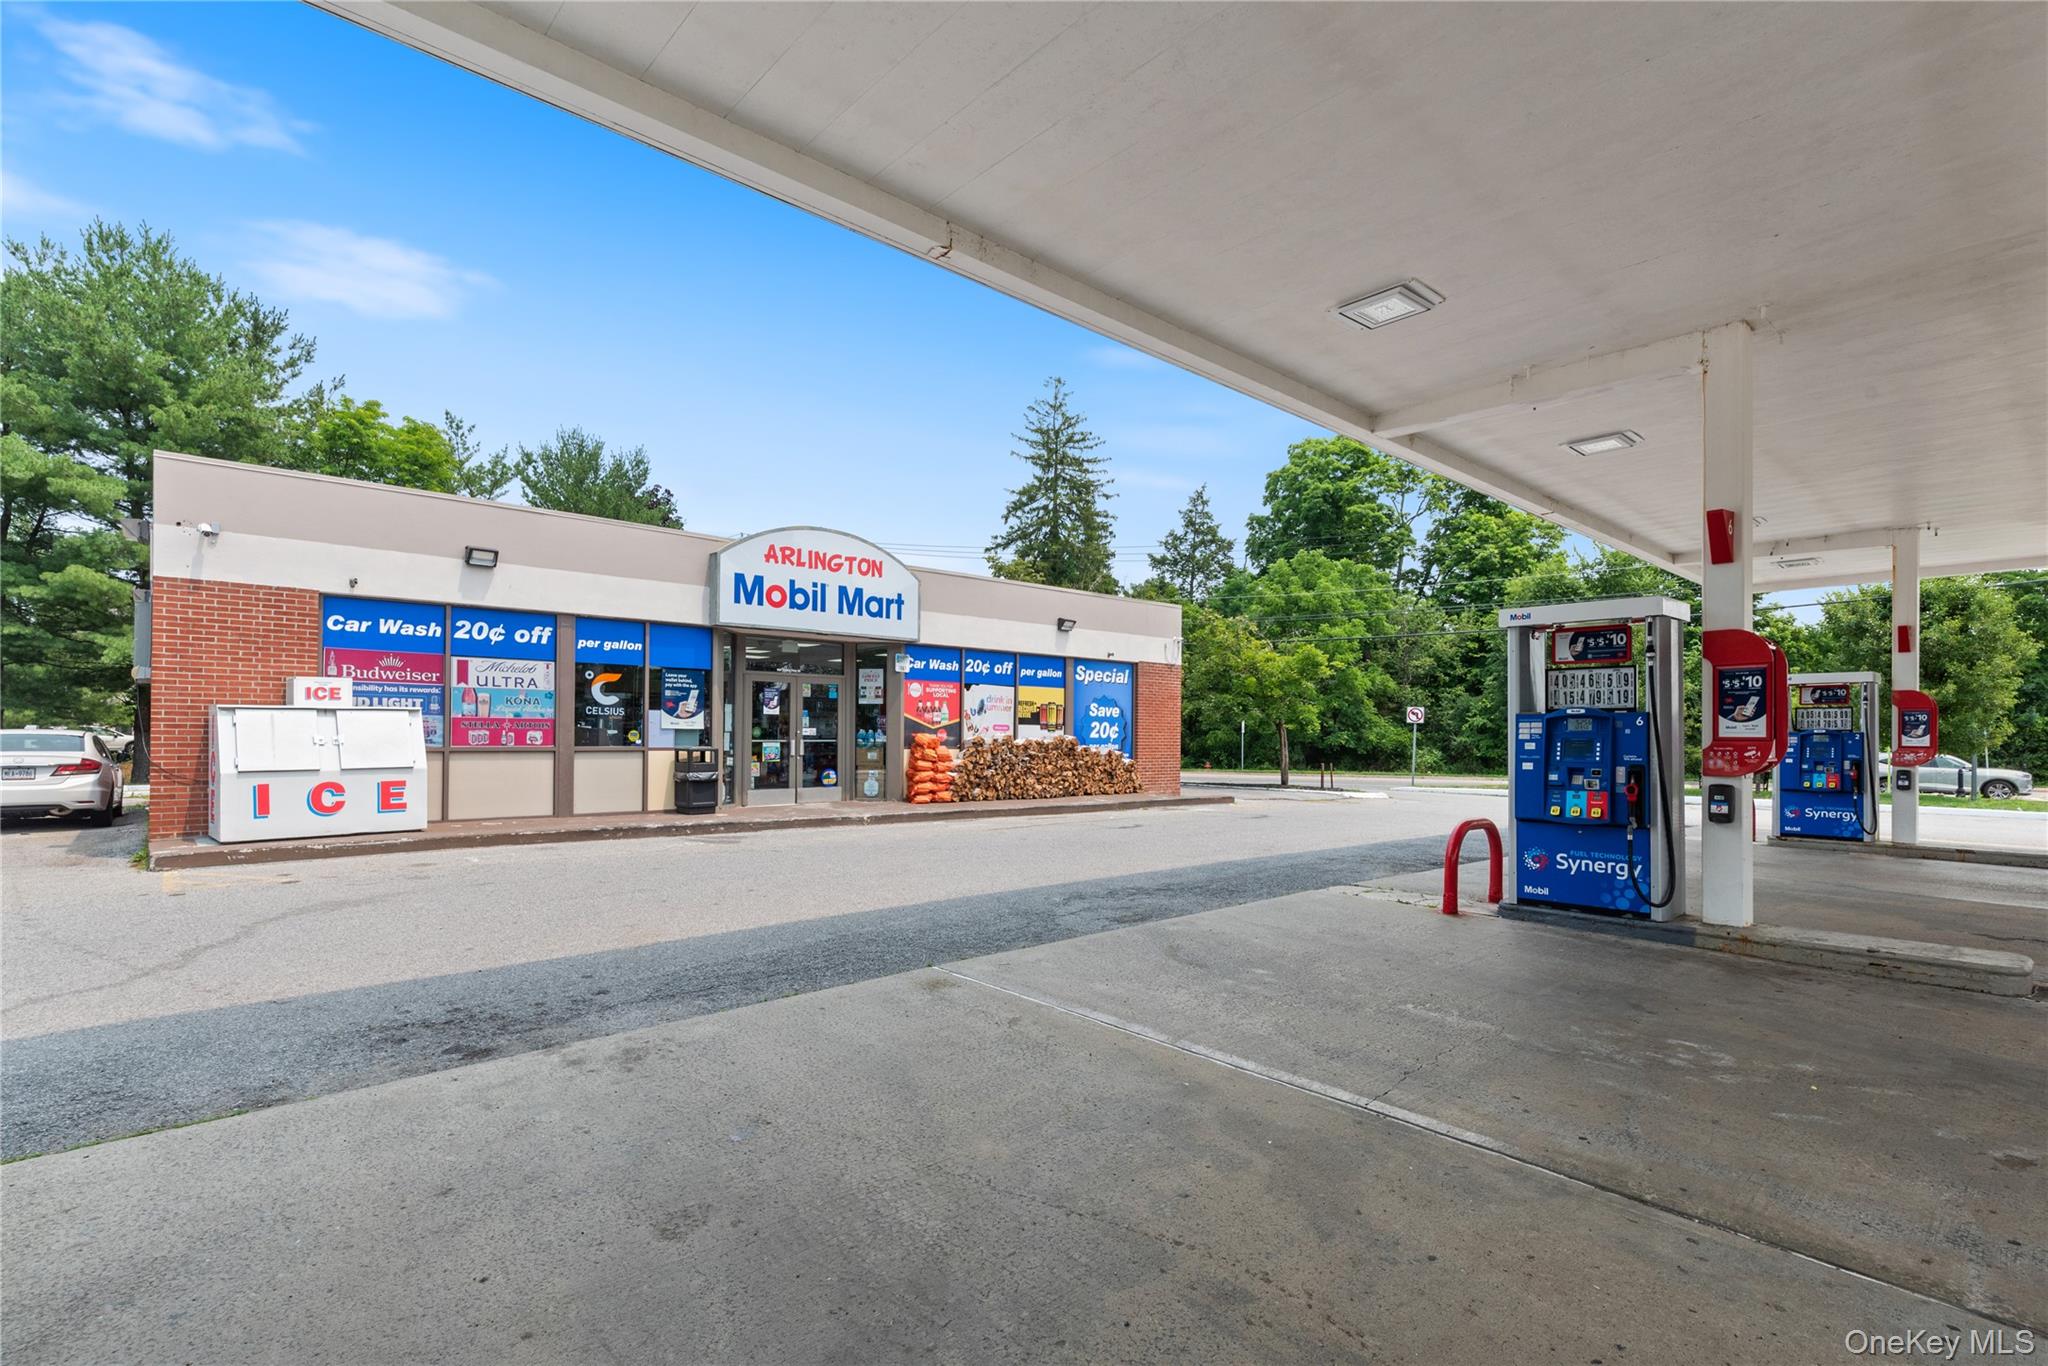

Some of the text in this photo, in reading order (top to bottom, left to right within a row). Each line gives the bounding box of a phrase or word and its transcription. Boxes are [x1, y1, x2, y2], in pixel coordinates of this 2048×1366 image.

[764, 544, 883, 578] ARLINGTON
[734, 572, 905, 620] Mobil Mart
[1510, 612, 1532, 621] Mobil
[326, 614, 442, 637] Car Wash
[453, 620, 553, 645] 20¢ off
[577, 639, 642, 651] per gallon
[929, 659, 959, 671] Wash
[965, 659, 1014, 676] 20¢ off
[341, 664, 440, 682] Budweiser
[1020, 668, 1062, 678] per gallon
[1075, 665, 1129, 684] Special
[476, 676, 538, 688] ULTRA
[304, 687, 342, 700] ICE
[353, 685, 382, 693] nsibility
[505, 696, 540, 705] KONA
[586, 706, 625, 715] CELSIUS
[1089, 703, 1120, 717] Save
[1636, 716, 1643, 726] 6
[1089, 721, 1119, 742] 20¢
[1805, 808, 1857, 822] Synergy
[1556, 853, 1642, 881] Synergy
[1524, 885, 1549, 895] Mobil
